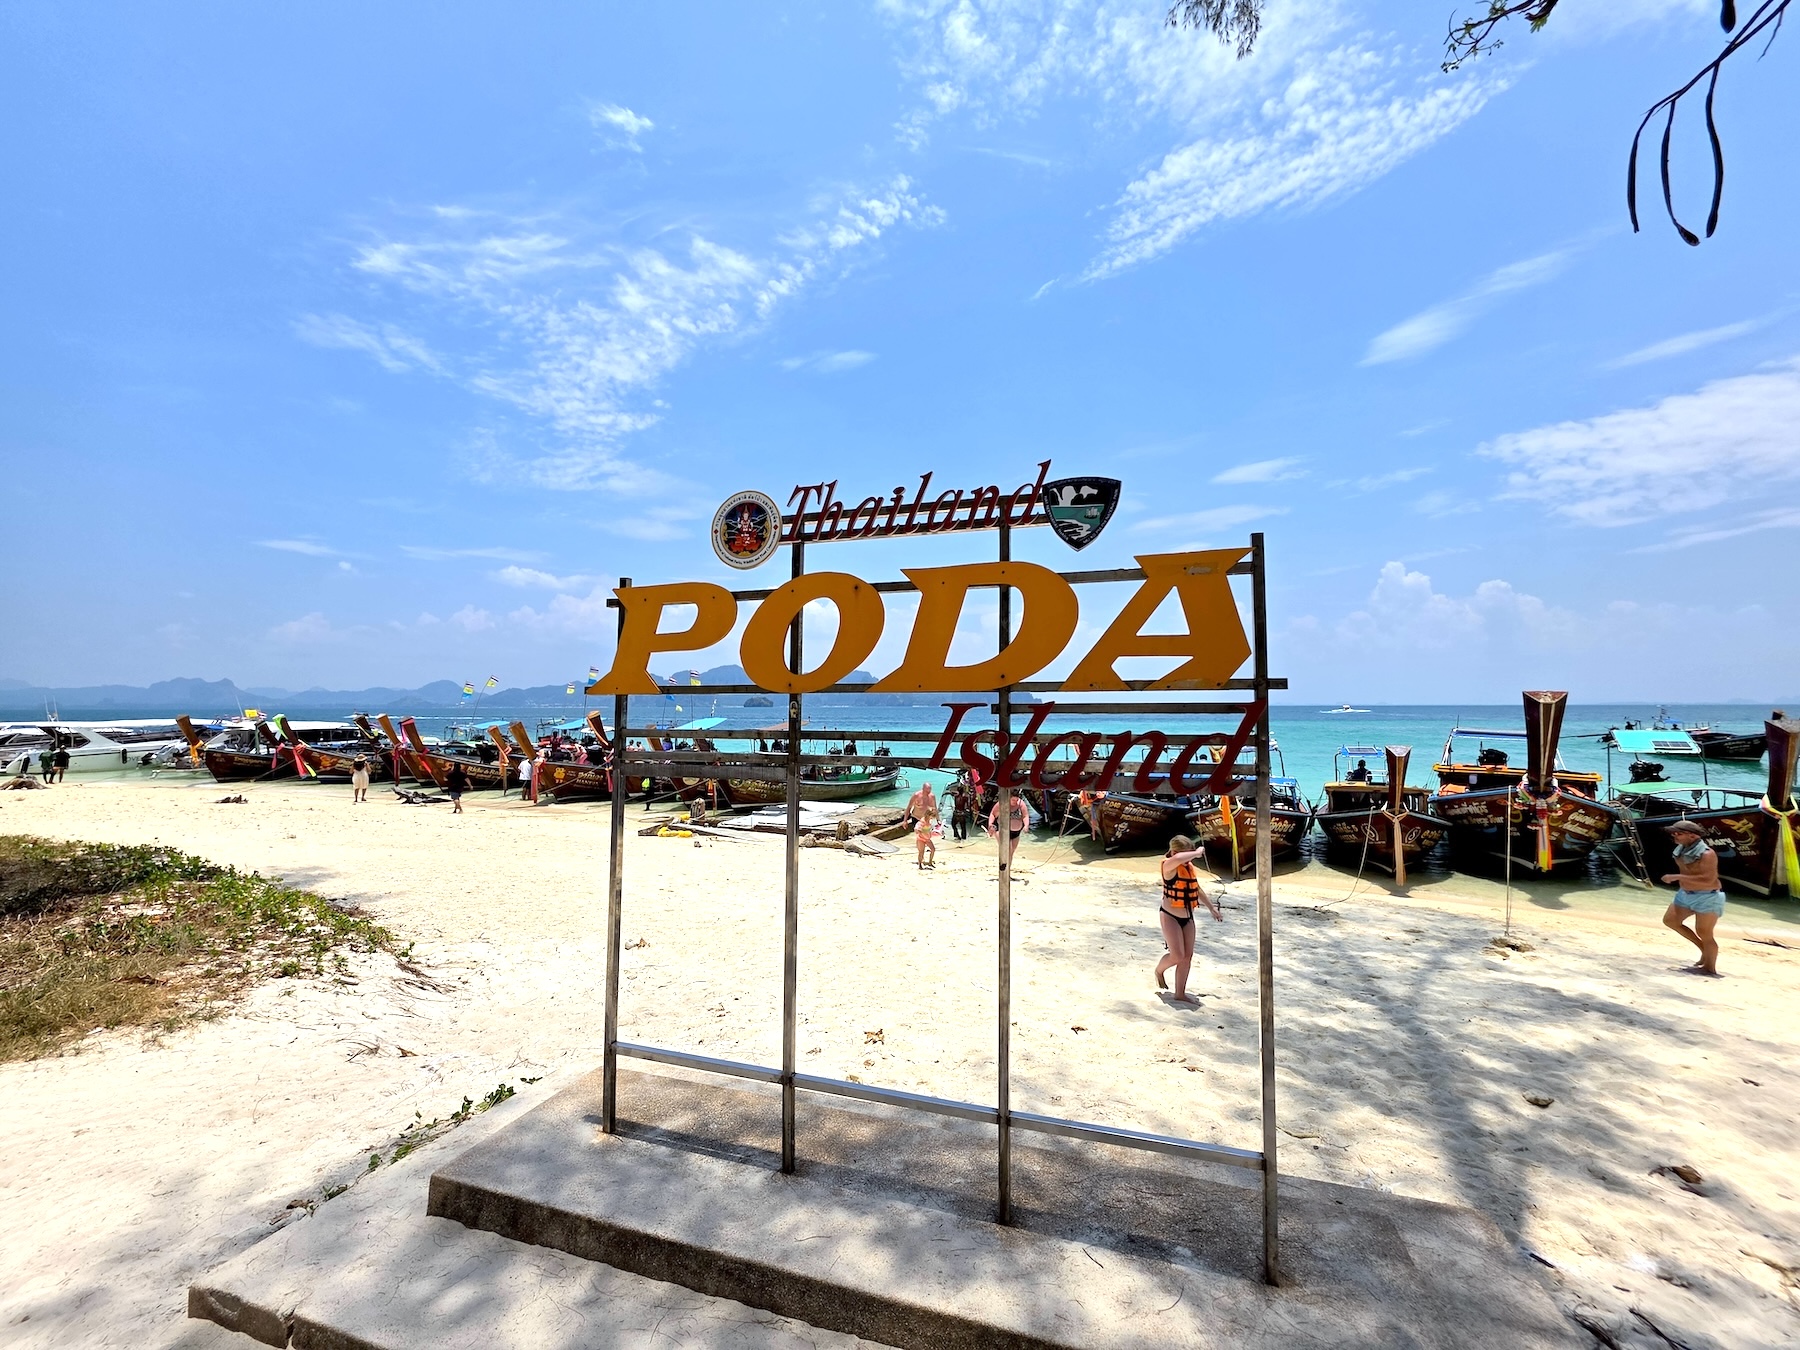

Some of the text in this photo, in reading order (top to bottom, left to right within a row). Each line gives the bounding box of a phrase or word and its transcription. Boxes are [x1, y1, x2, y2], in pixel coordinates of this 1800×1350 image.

[783, 459, 1052, 541] Thailand
[587, 547, 1253, 694] PODA
[928, 700, 1267, 796] Island
